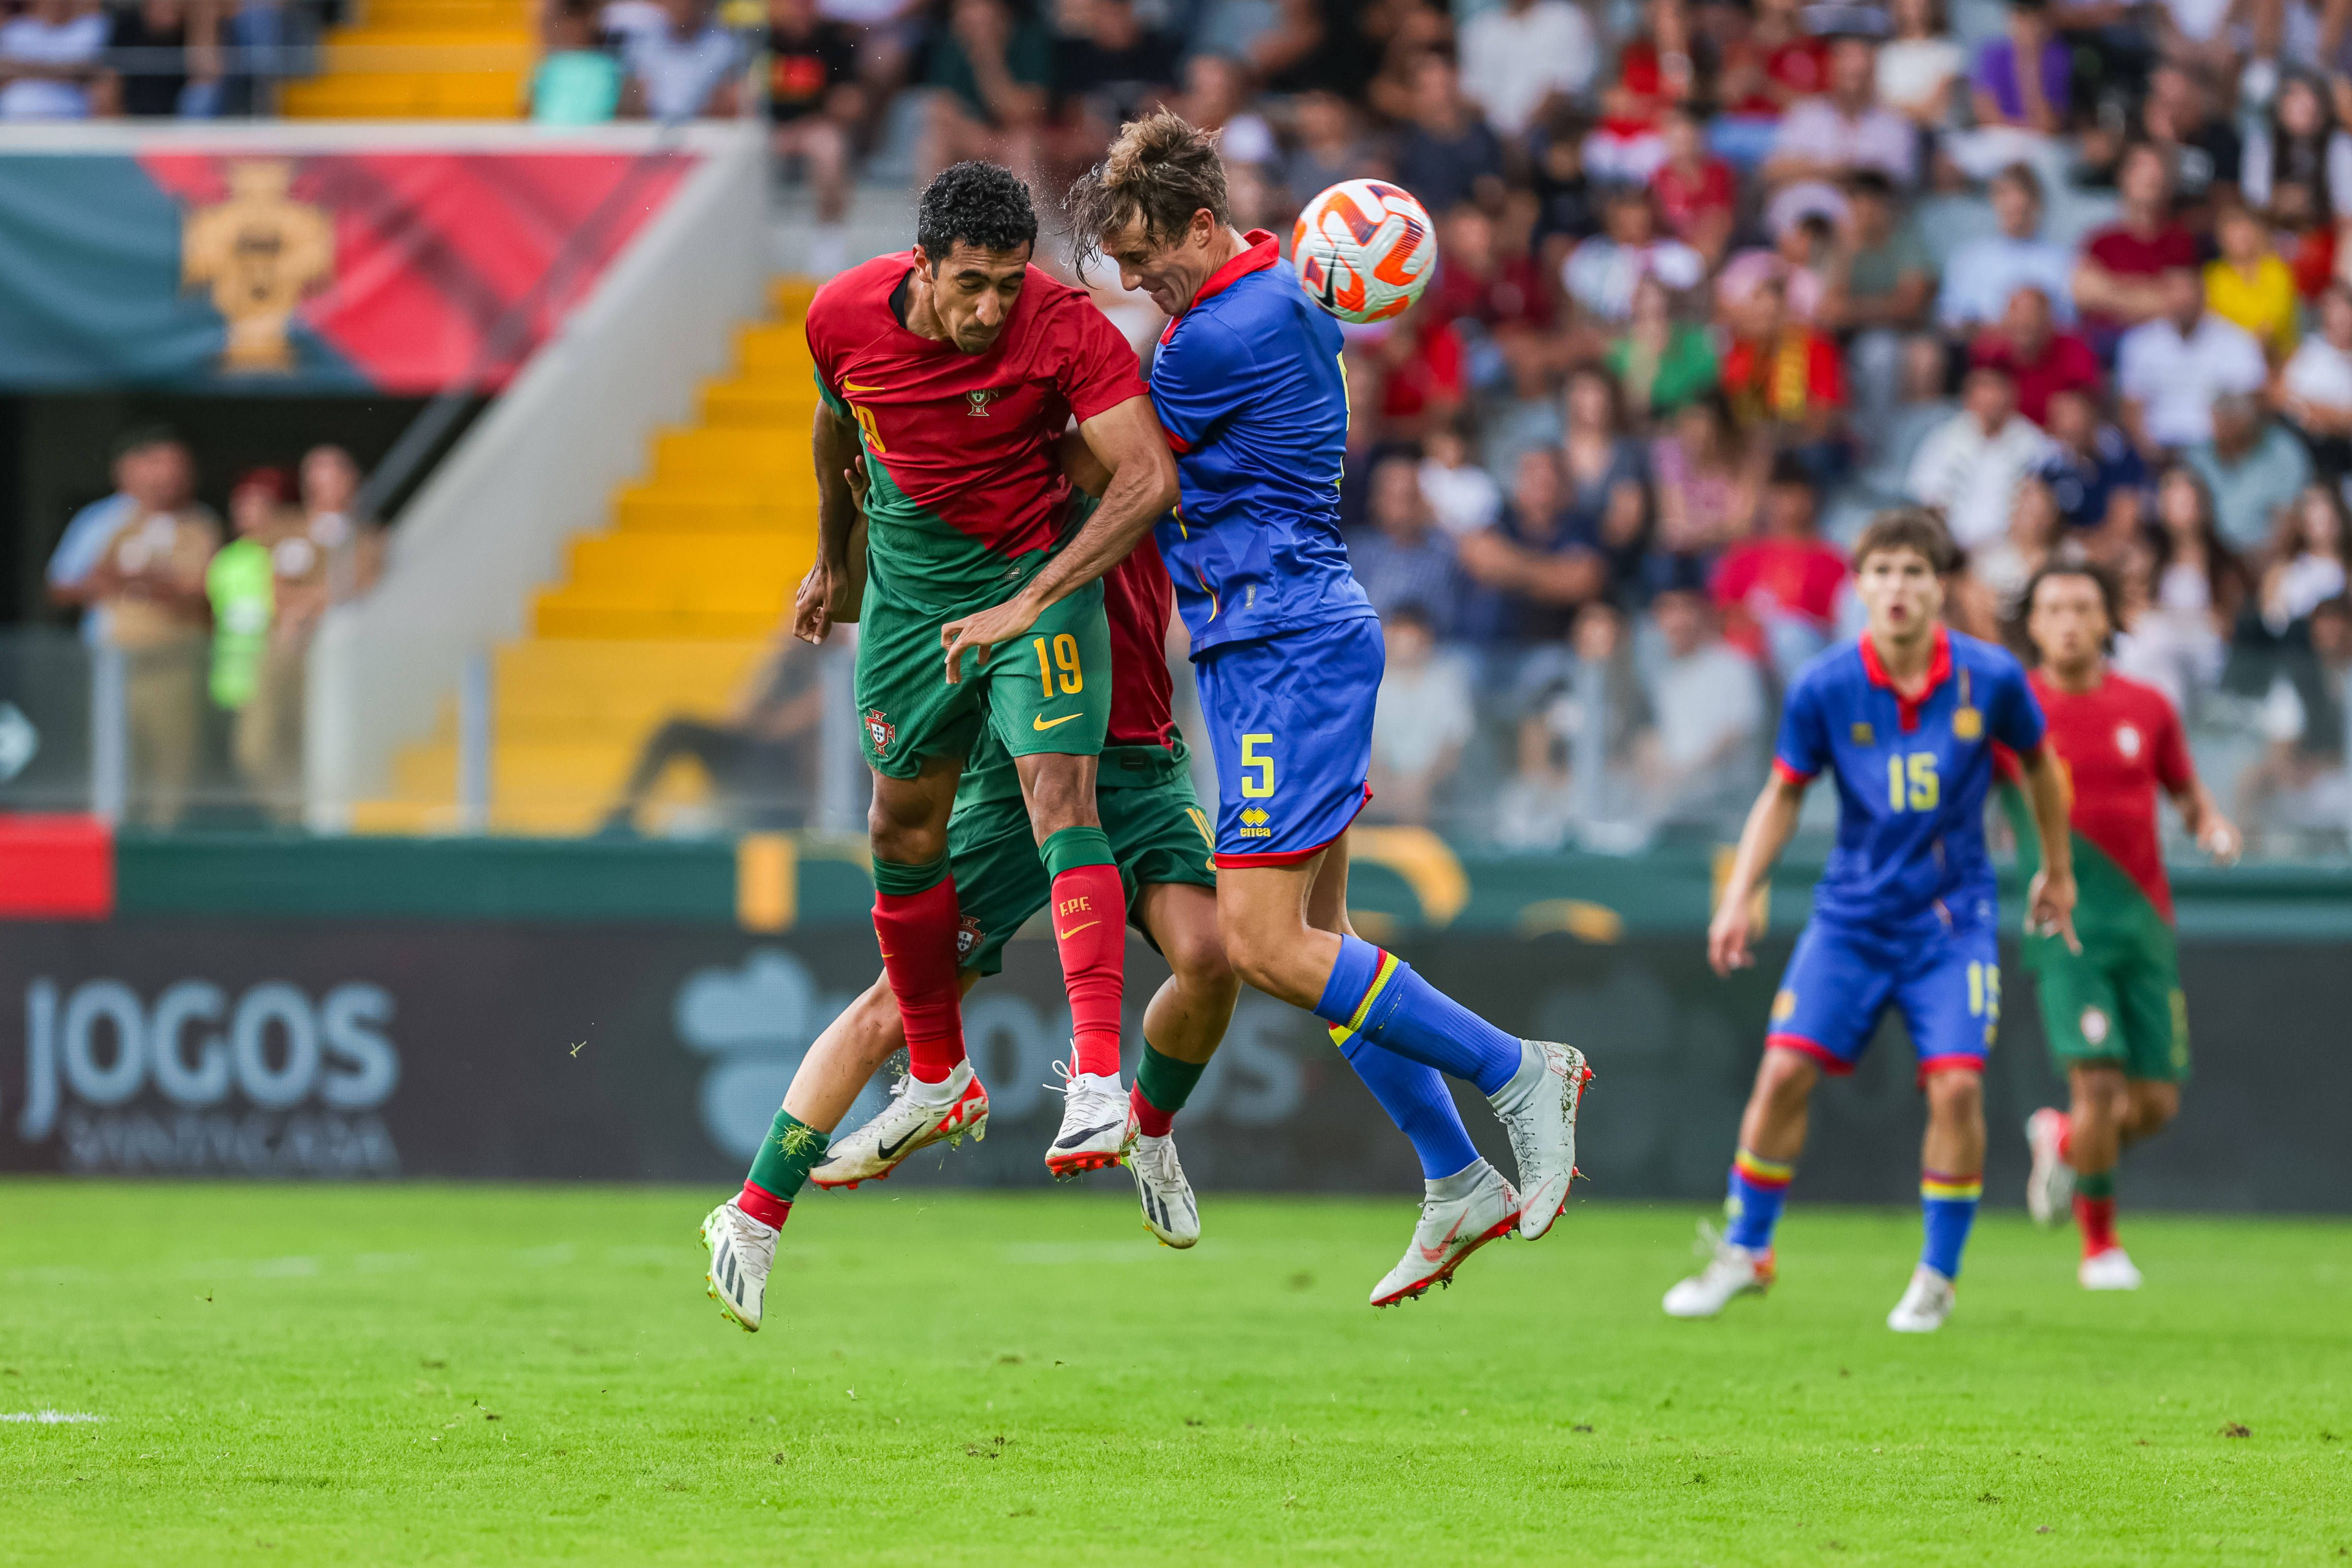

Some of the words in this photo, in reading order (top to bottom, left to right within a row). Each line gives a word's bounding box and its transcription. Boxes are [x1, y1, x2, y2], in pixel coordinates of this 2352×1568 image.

[1033, 633, 1083, 698] 19
[1241, 734, 1274, 798] 5
[1887, 753, 1940, 813] 15
[1240, 827, 1271, 837] errea
[19, 977, 400, 1140] JOGOS
